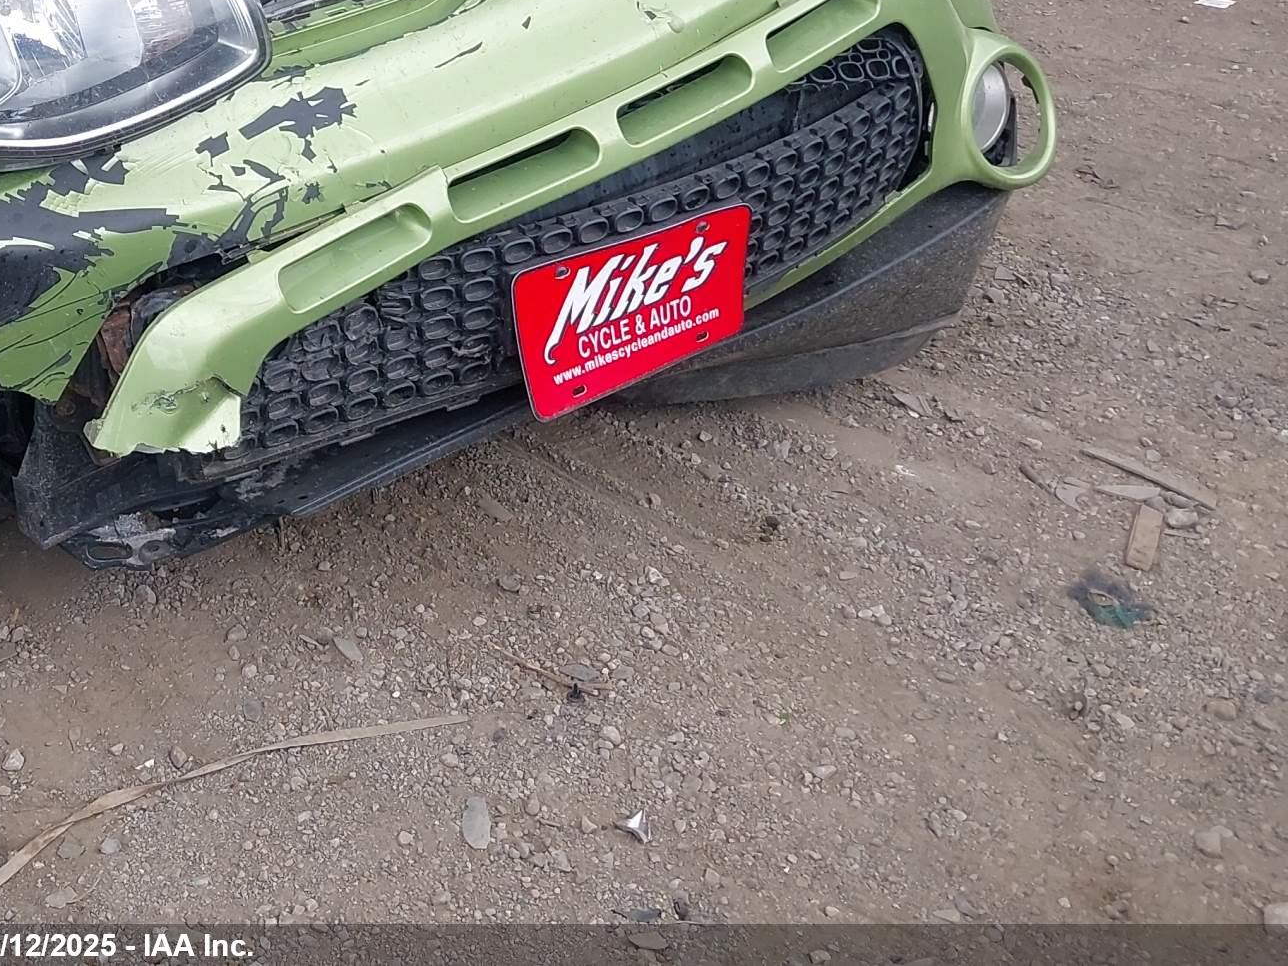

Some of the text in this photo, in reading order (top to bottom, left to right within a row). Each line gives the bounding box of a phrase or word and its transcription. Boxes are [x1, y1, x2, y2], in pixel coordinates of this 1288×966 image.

[544, 236, 728, 365] Mike's
[578, 295, 692, 359] CYCLE & AUTO
[553, 307, 719, 385] www.mikescycleandauto.com
